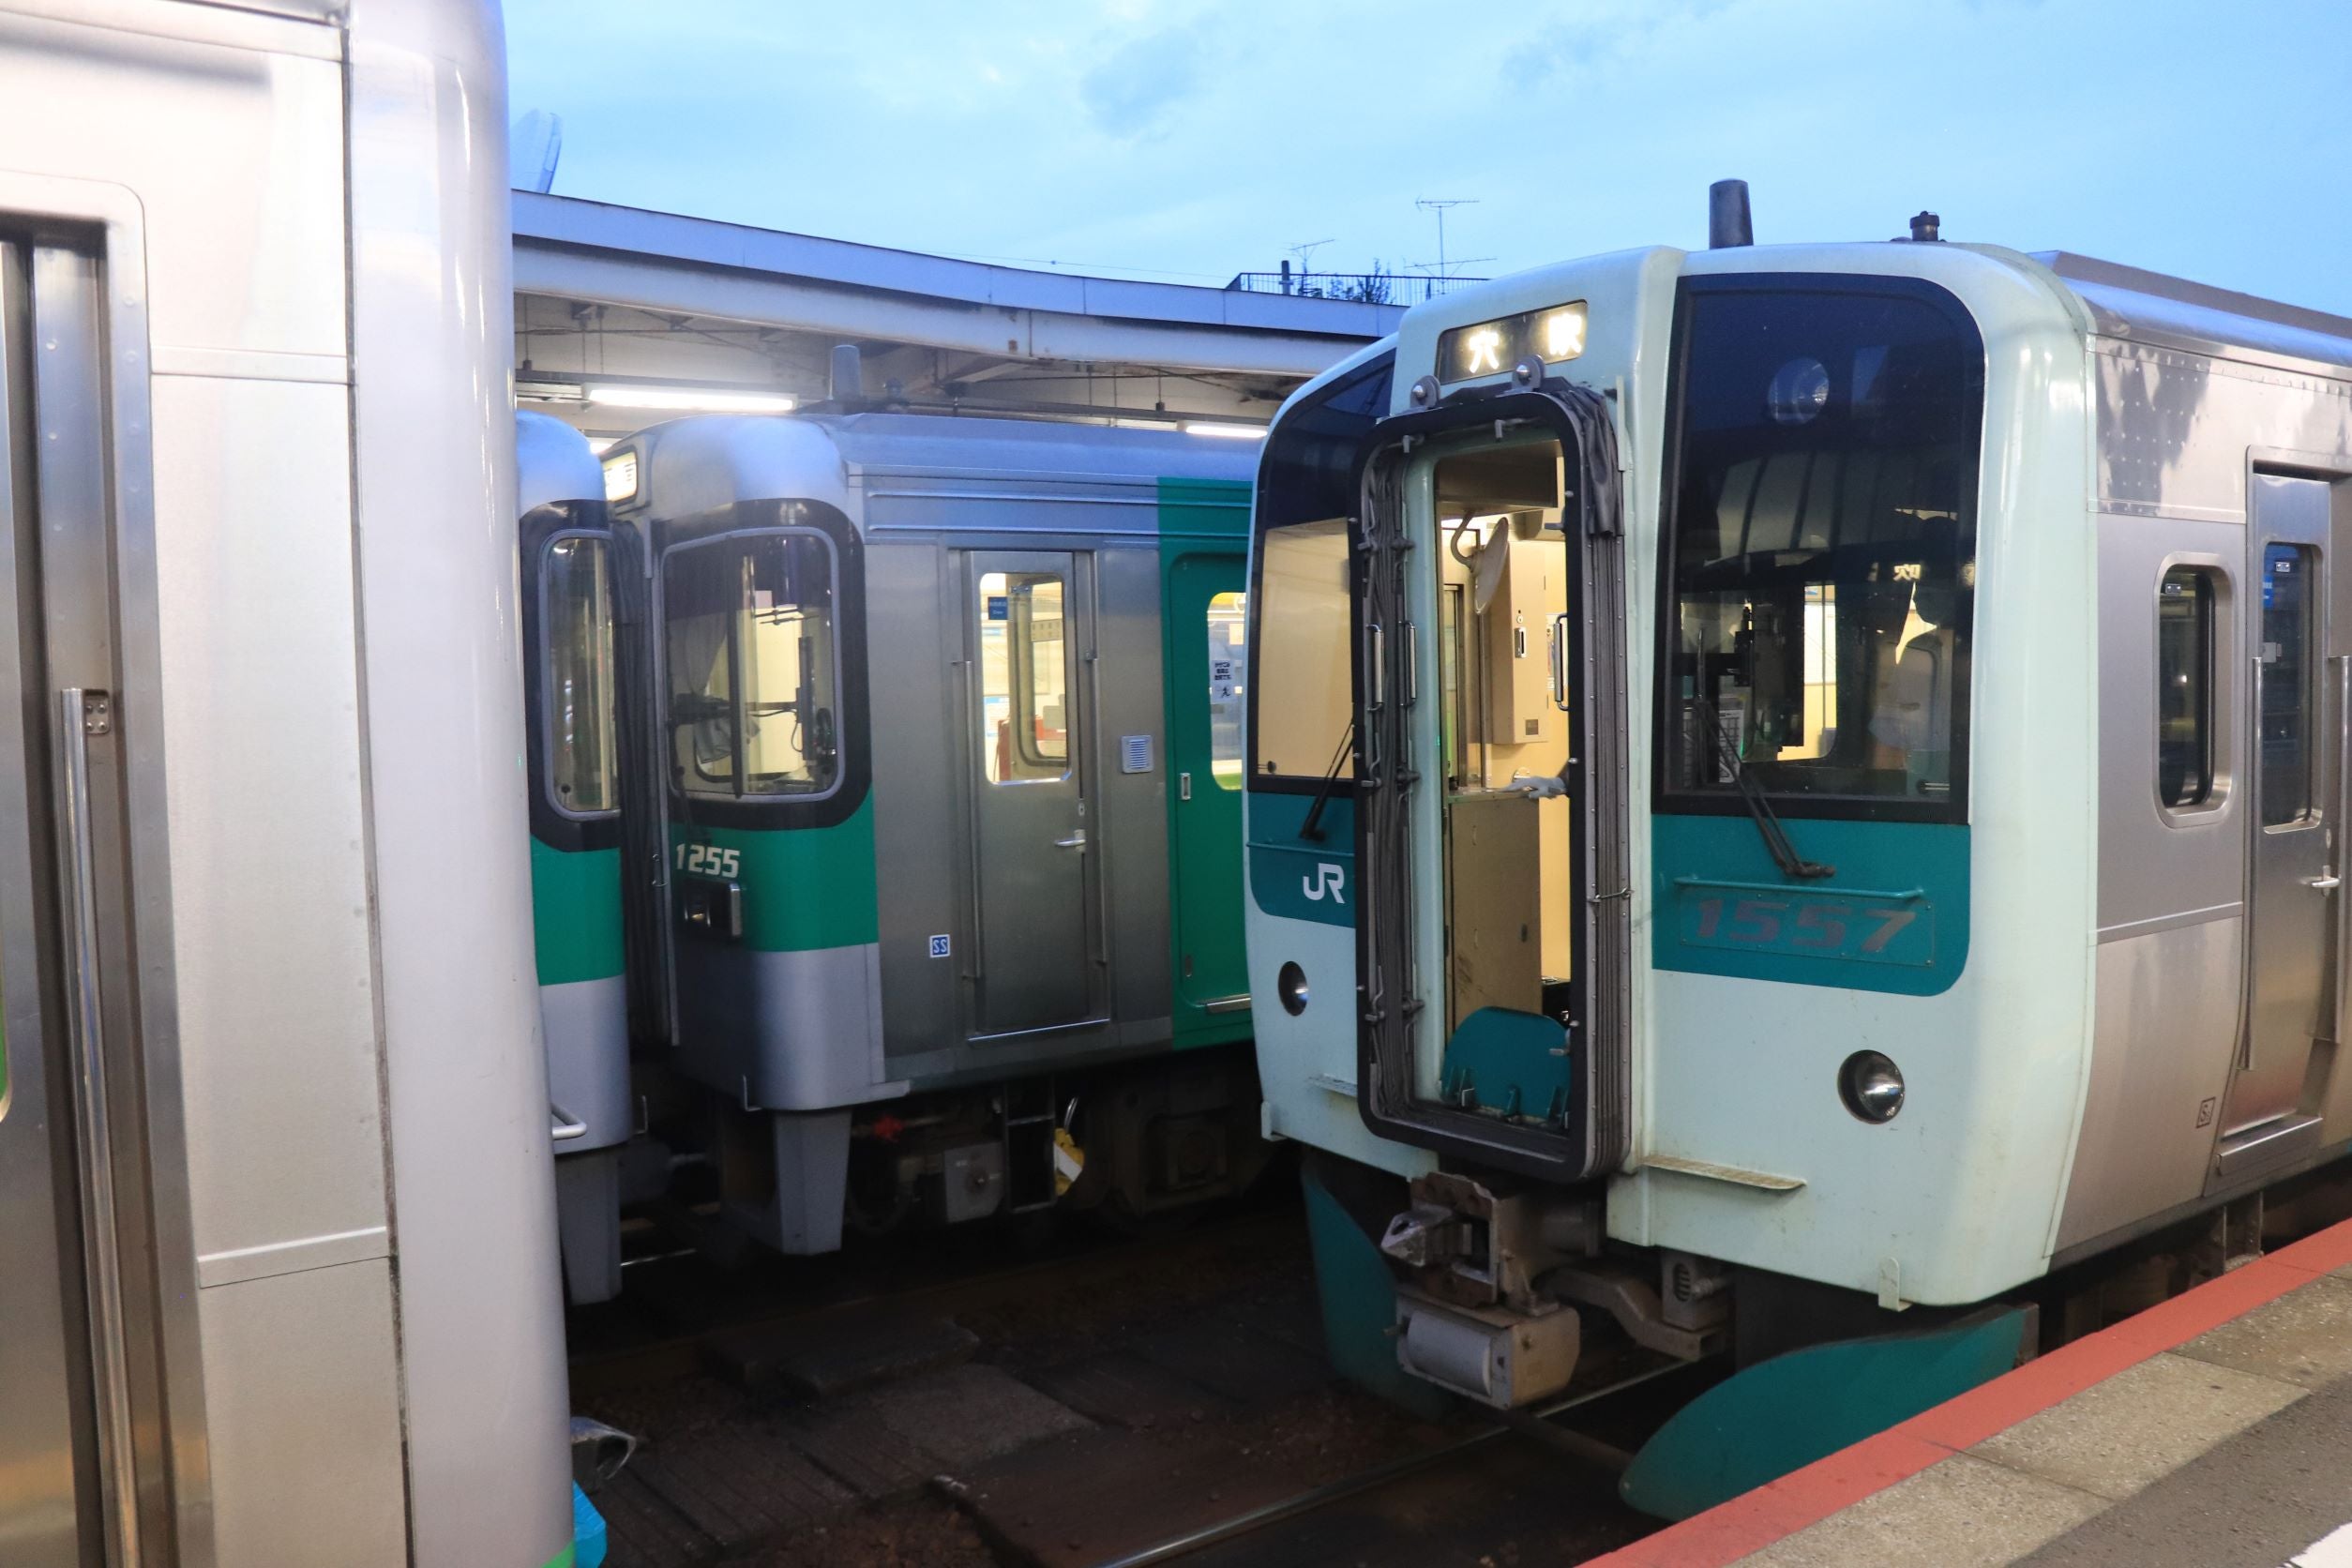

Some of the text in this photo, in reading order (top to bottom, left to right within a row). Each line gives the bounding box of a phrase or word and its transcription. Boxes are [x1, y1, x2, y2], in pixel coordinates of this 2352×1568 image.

[676, 843, 740, 878] 1255
[1303, 863, 1346, 904] JR
[1697, 899, 1916, 953] 1557
[933, 939, 947, 954] SS
